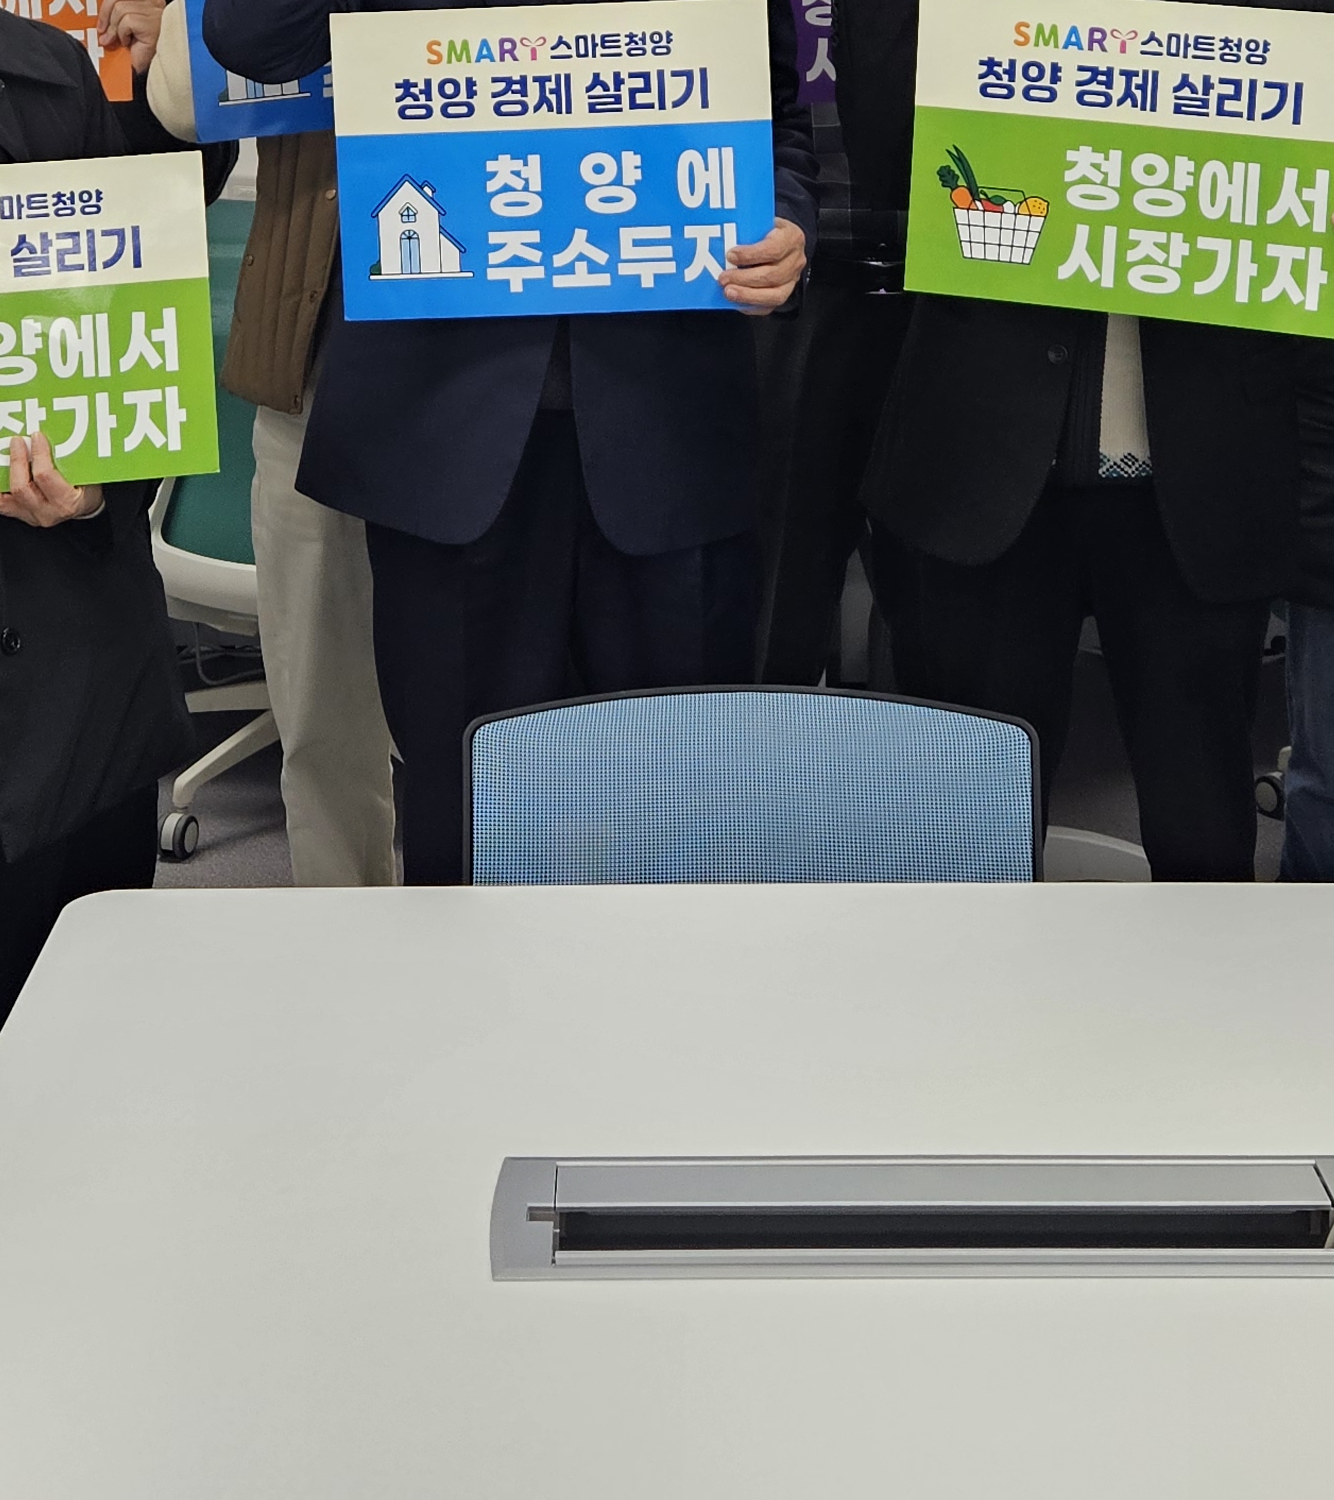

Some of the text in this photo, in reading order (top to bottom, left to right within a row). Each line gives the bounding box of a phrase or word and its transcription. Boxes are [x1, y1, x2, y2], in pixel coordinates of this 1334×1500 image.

[550, 30, 674, 60] 스마트청양
[1139, 30, 1271, 66] 스마트청양
[394, 67, 710, 120] 청양 경제 살리기
[977, 56, 1304, 126] 청양 경제 살리기
[1064, 145, 1330, 234] 청양에서
[10, 225, 143, 278] 살리기
[1056, 223, 1329, 312] 시장가자
